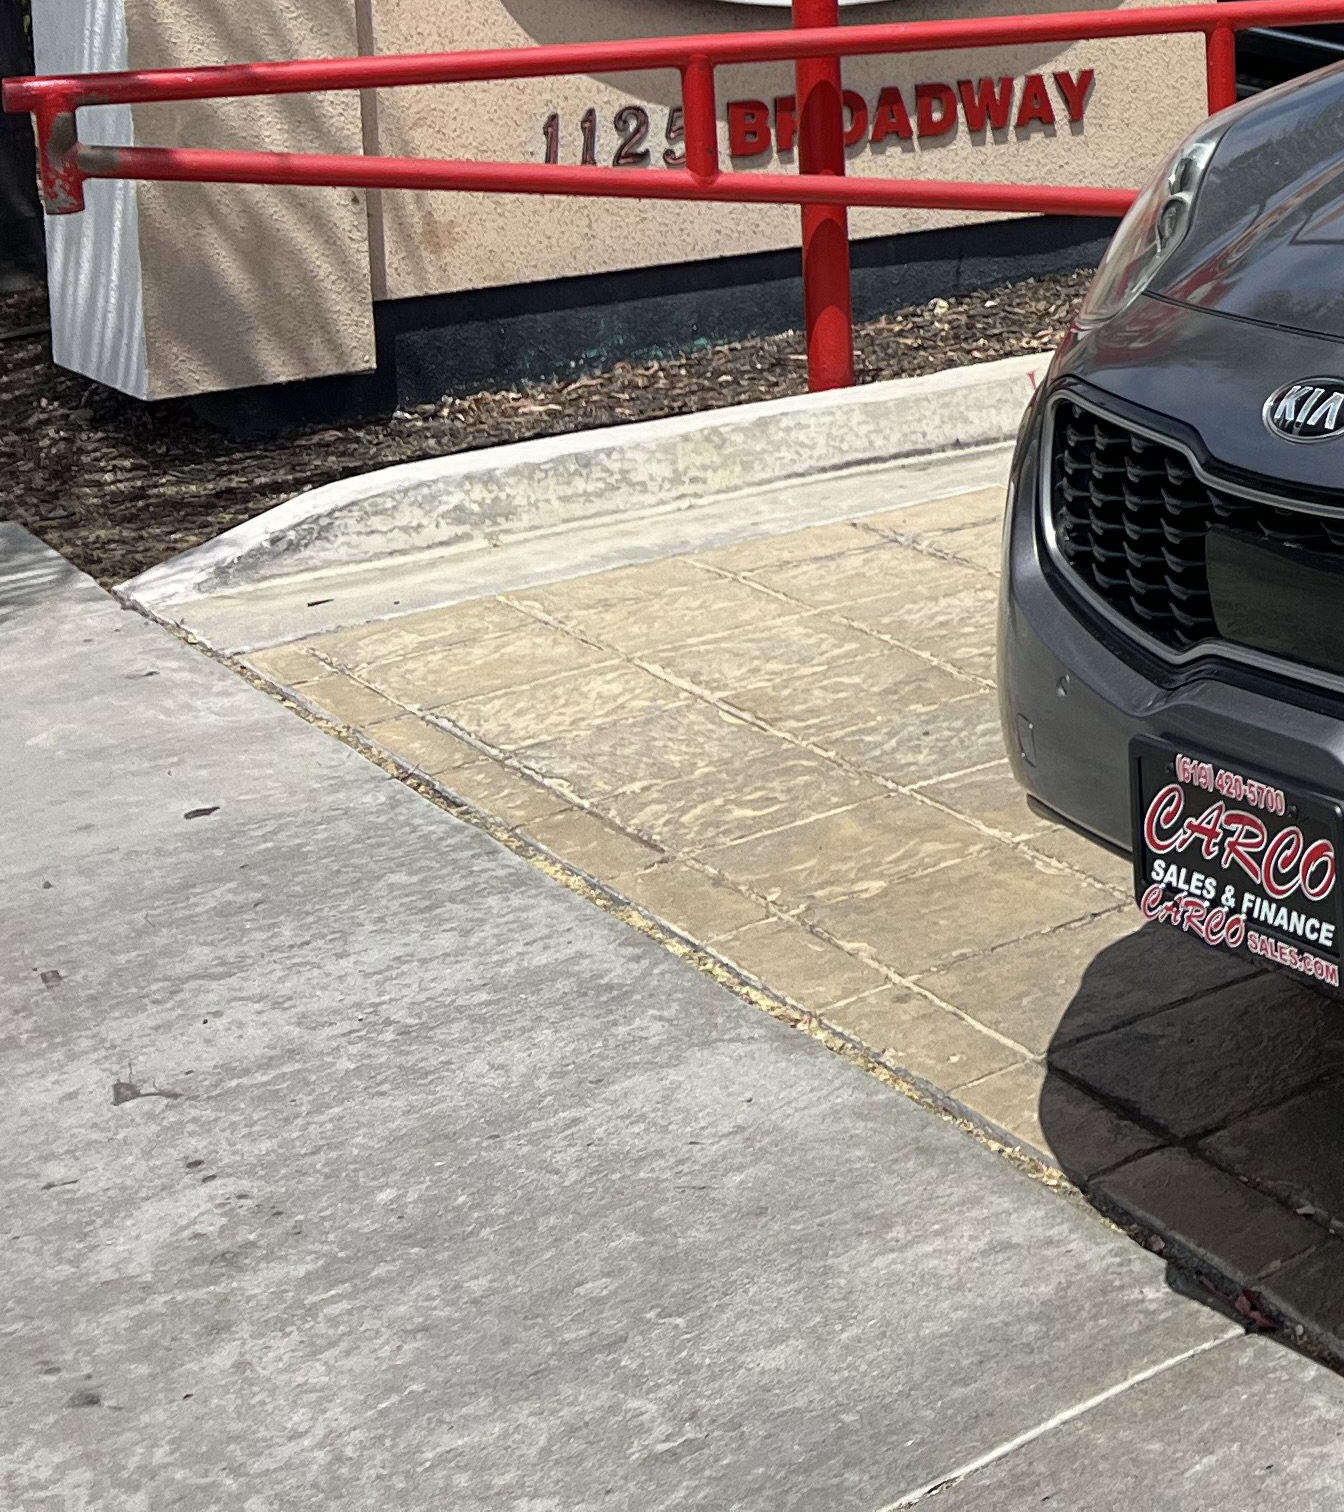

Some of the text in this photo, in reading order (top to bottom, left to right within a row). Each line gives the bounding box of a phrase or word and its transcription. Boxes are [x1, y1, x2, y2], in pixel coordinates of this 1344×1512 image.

[541, 105, 687, 167] 1125
[1175, 753, 1286, 817] (619) 420-5700
[1144, 783, 1336, 901] CARCO
[1150, 858, 1336, 947] SALES & FINANCE
